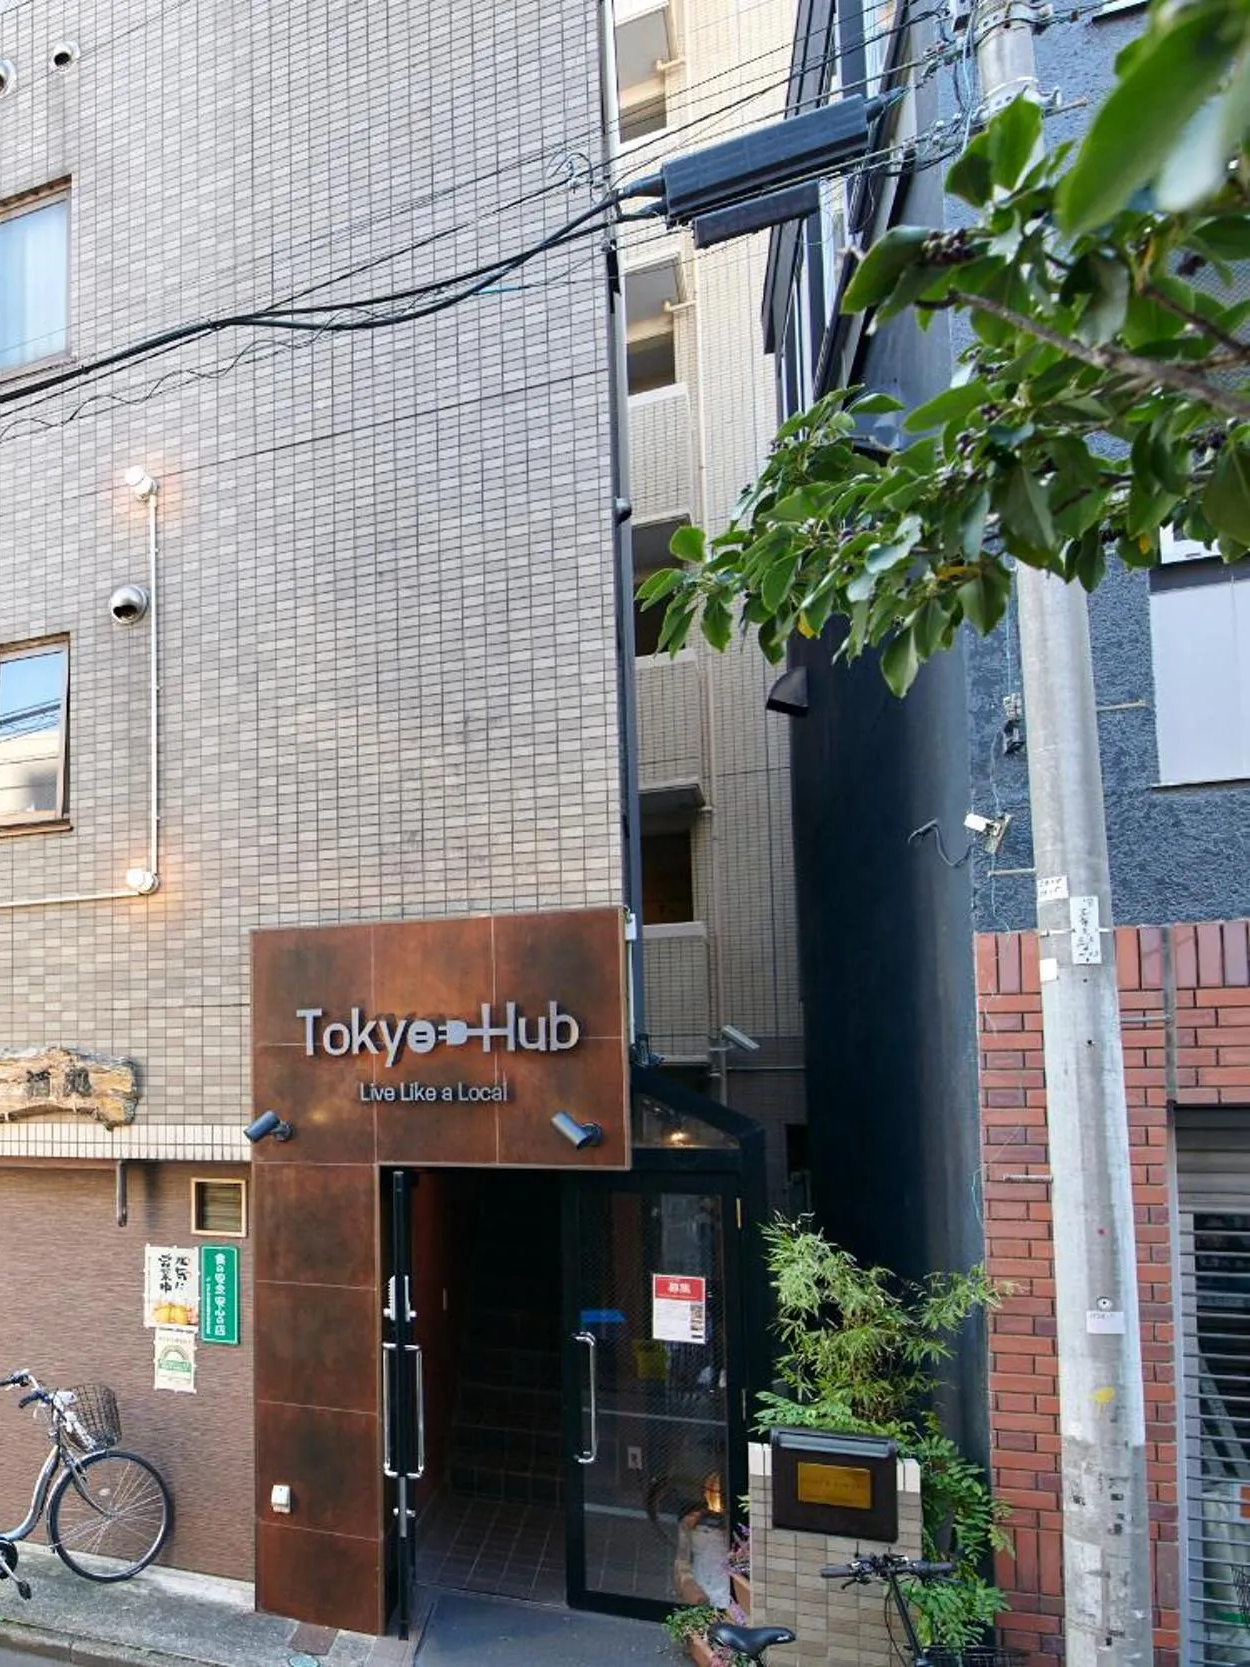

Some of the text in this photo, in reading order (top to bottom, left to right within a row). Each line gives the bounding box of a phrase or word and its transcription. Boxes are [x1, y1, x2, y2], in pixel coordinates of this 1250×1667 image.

[296, 1001, 579, 1067] Tokyo Hub
[360, 1081, 508, 1102] Live Like a Local
